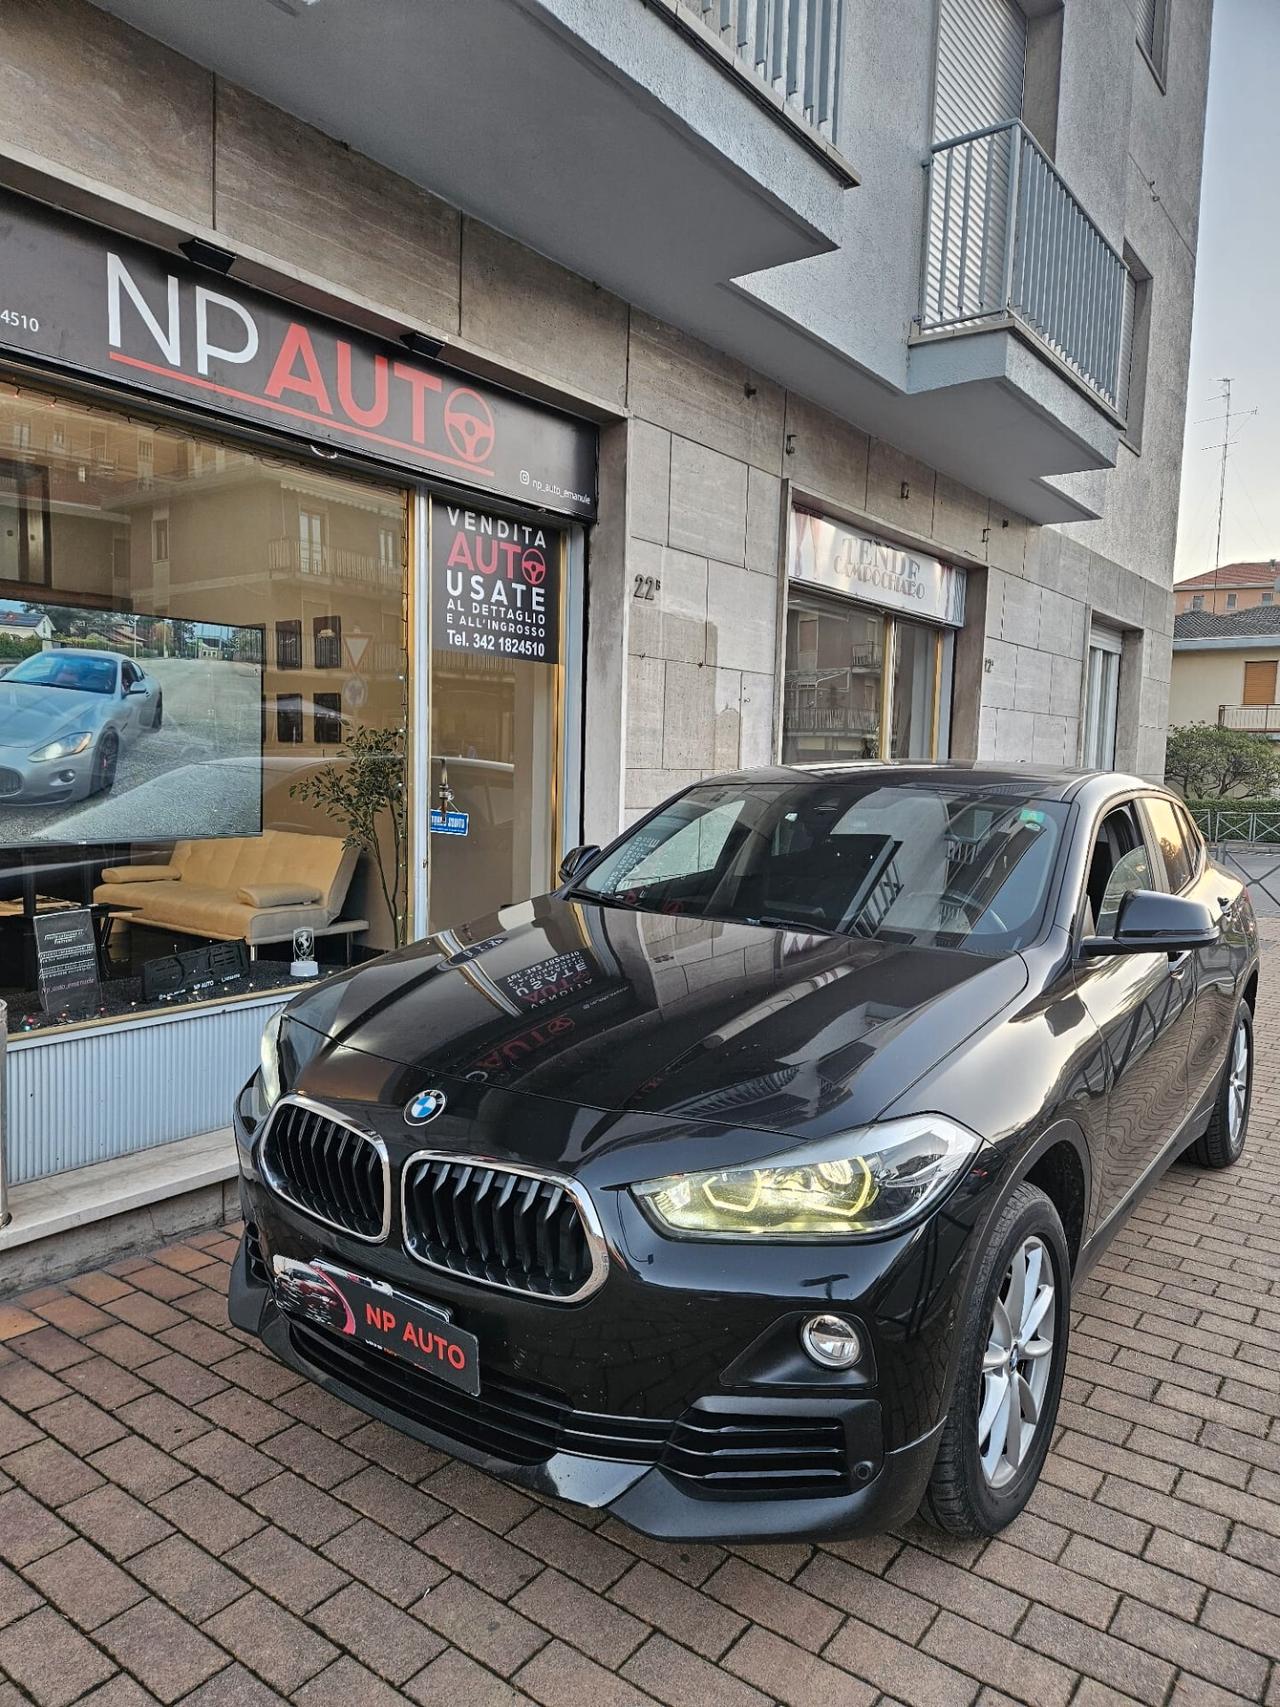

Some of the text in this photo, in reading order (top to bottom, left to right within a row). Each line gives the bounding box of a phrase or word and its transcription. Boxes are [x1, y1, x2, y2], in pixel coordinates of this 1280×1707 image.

[0, 309, 39, 332] 4510
[447, 506, 547, 549] VENDITA
[447, 531, 546, 585] AUTO
[446, 569, 546, 612] USATE
[446, 613, 546, 638] E ALL'INGROSSO
[447, 598, 546, 625] AL DETTAGLIO
[446, 629, 546, 658] Tel. 342 1824510
[366, 1302, 466, 1371] NP AUTO
